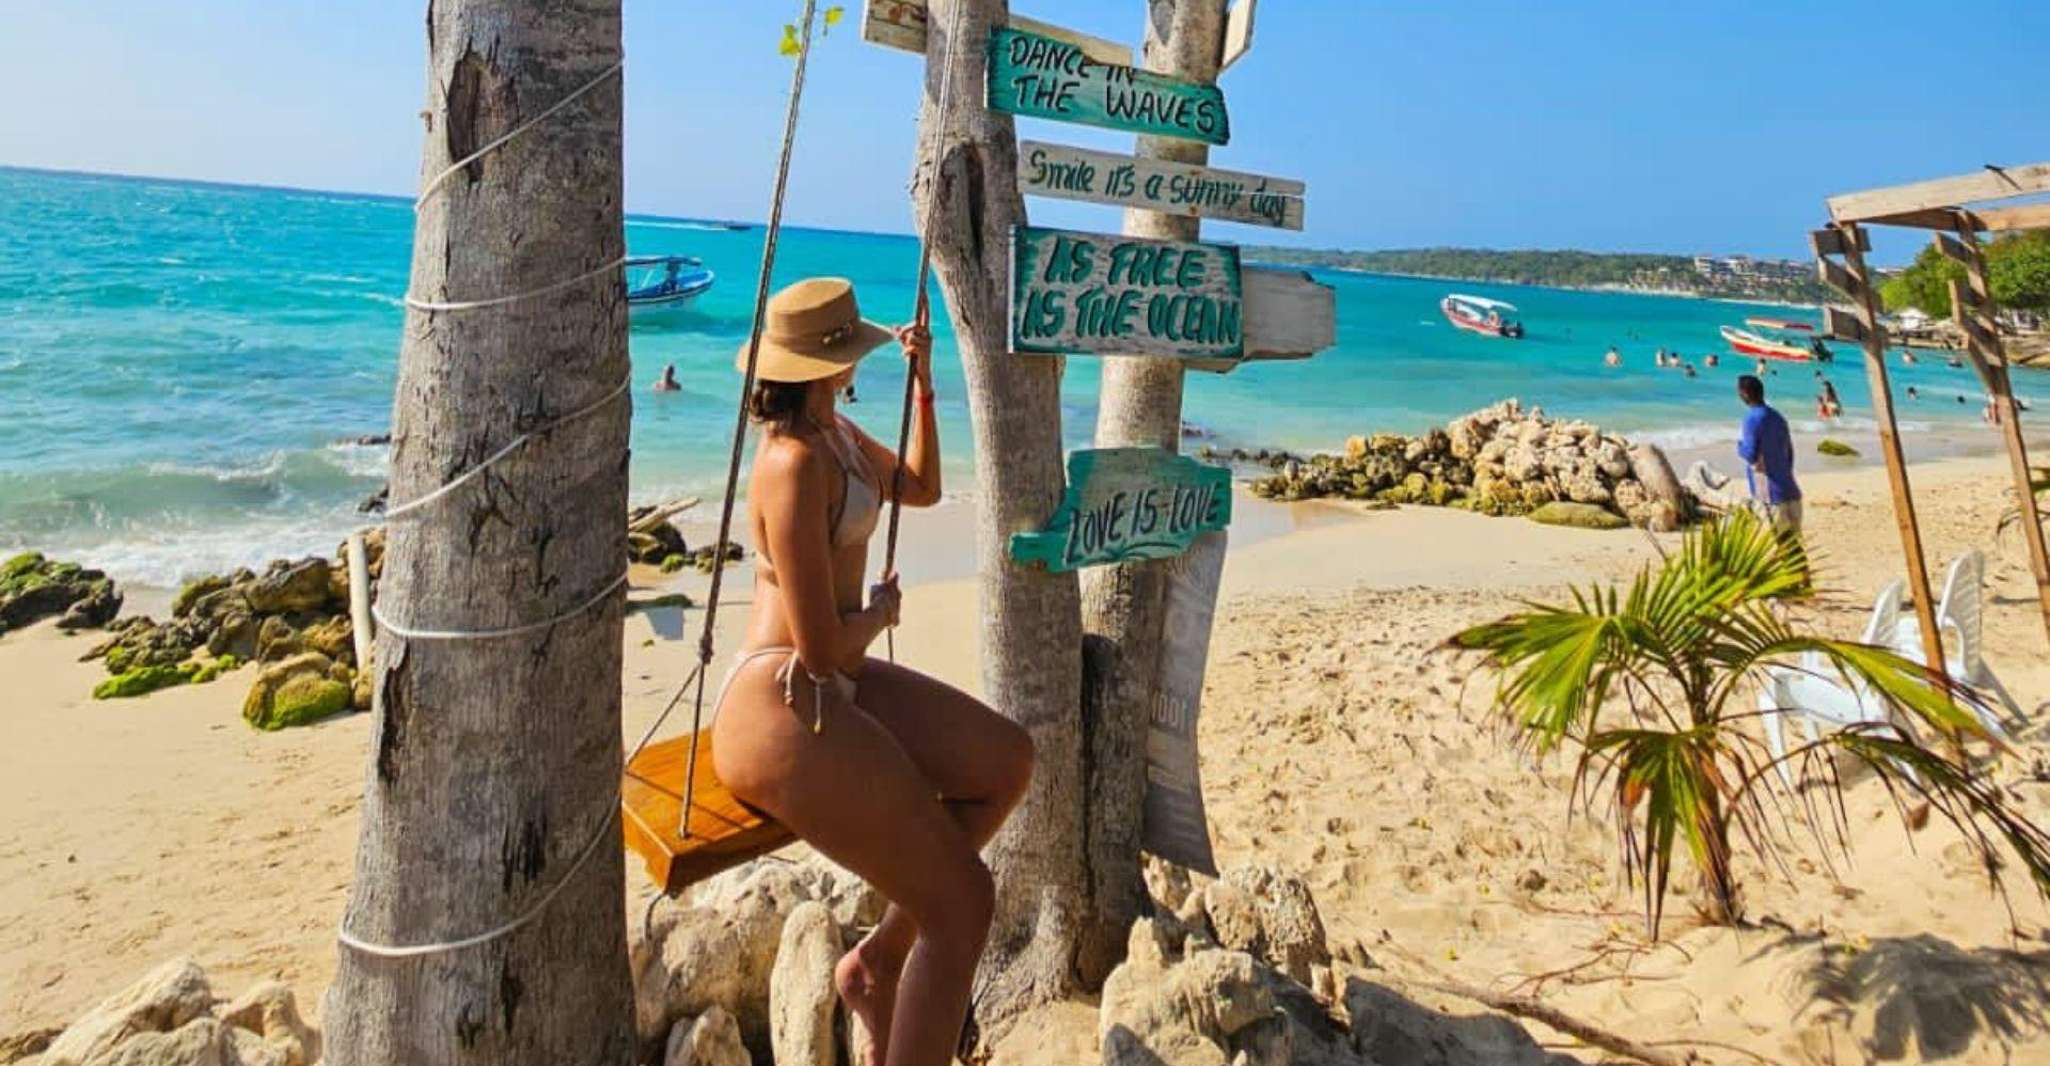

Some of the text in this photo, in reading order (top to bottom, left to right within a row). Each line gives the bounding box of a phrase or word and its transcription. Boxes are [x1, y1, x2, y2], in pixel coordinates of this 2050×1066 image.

[1009, 36, 1090, 78] DANCE
[1013, 74, 1215, 134] THE WAVES
[1029, 150, 1095, 193] Smile
[1145, 174, 1164, 201] a
[1169, 174, 1244, 210] sunny
[1249, 177, 1286, 228] day
[1044, 236, 1206, 288] AS FREE
[1021, 286, 1240, 345] AS THE OCEAN
[1063, 491, 1126, 566] LOVE
[1167, 482, 1221, 535] LOVE
